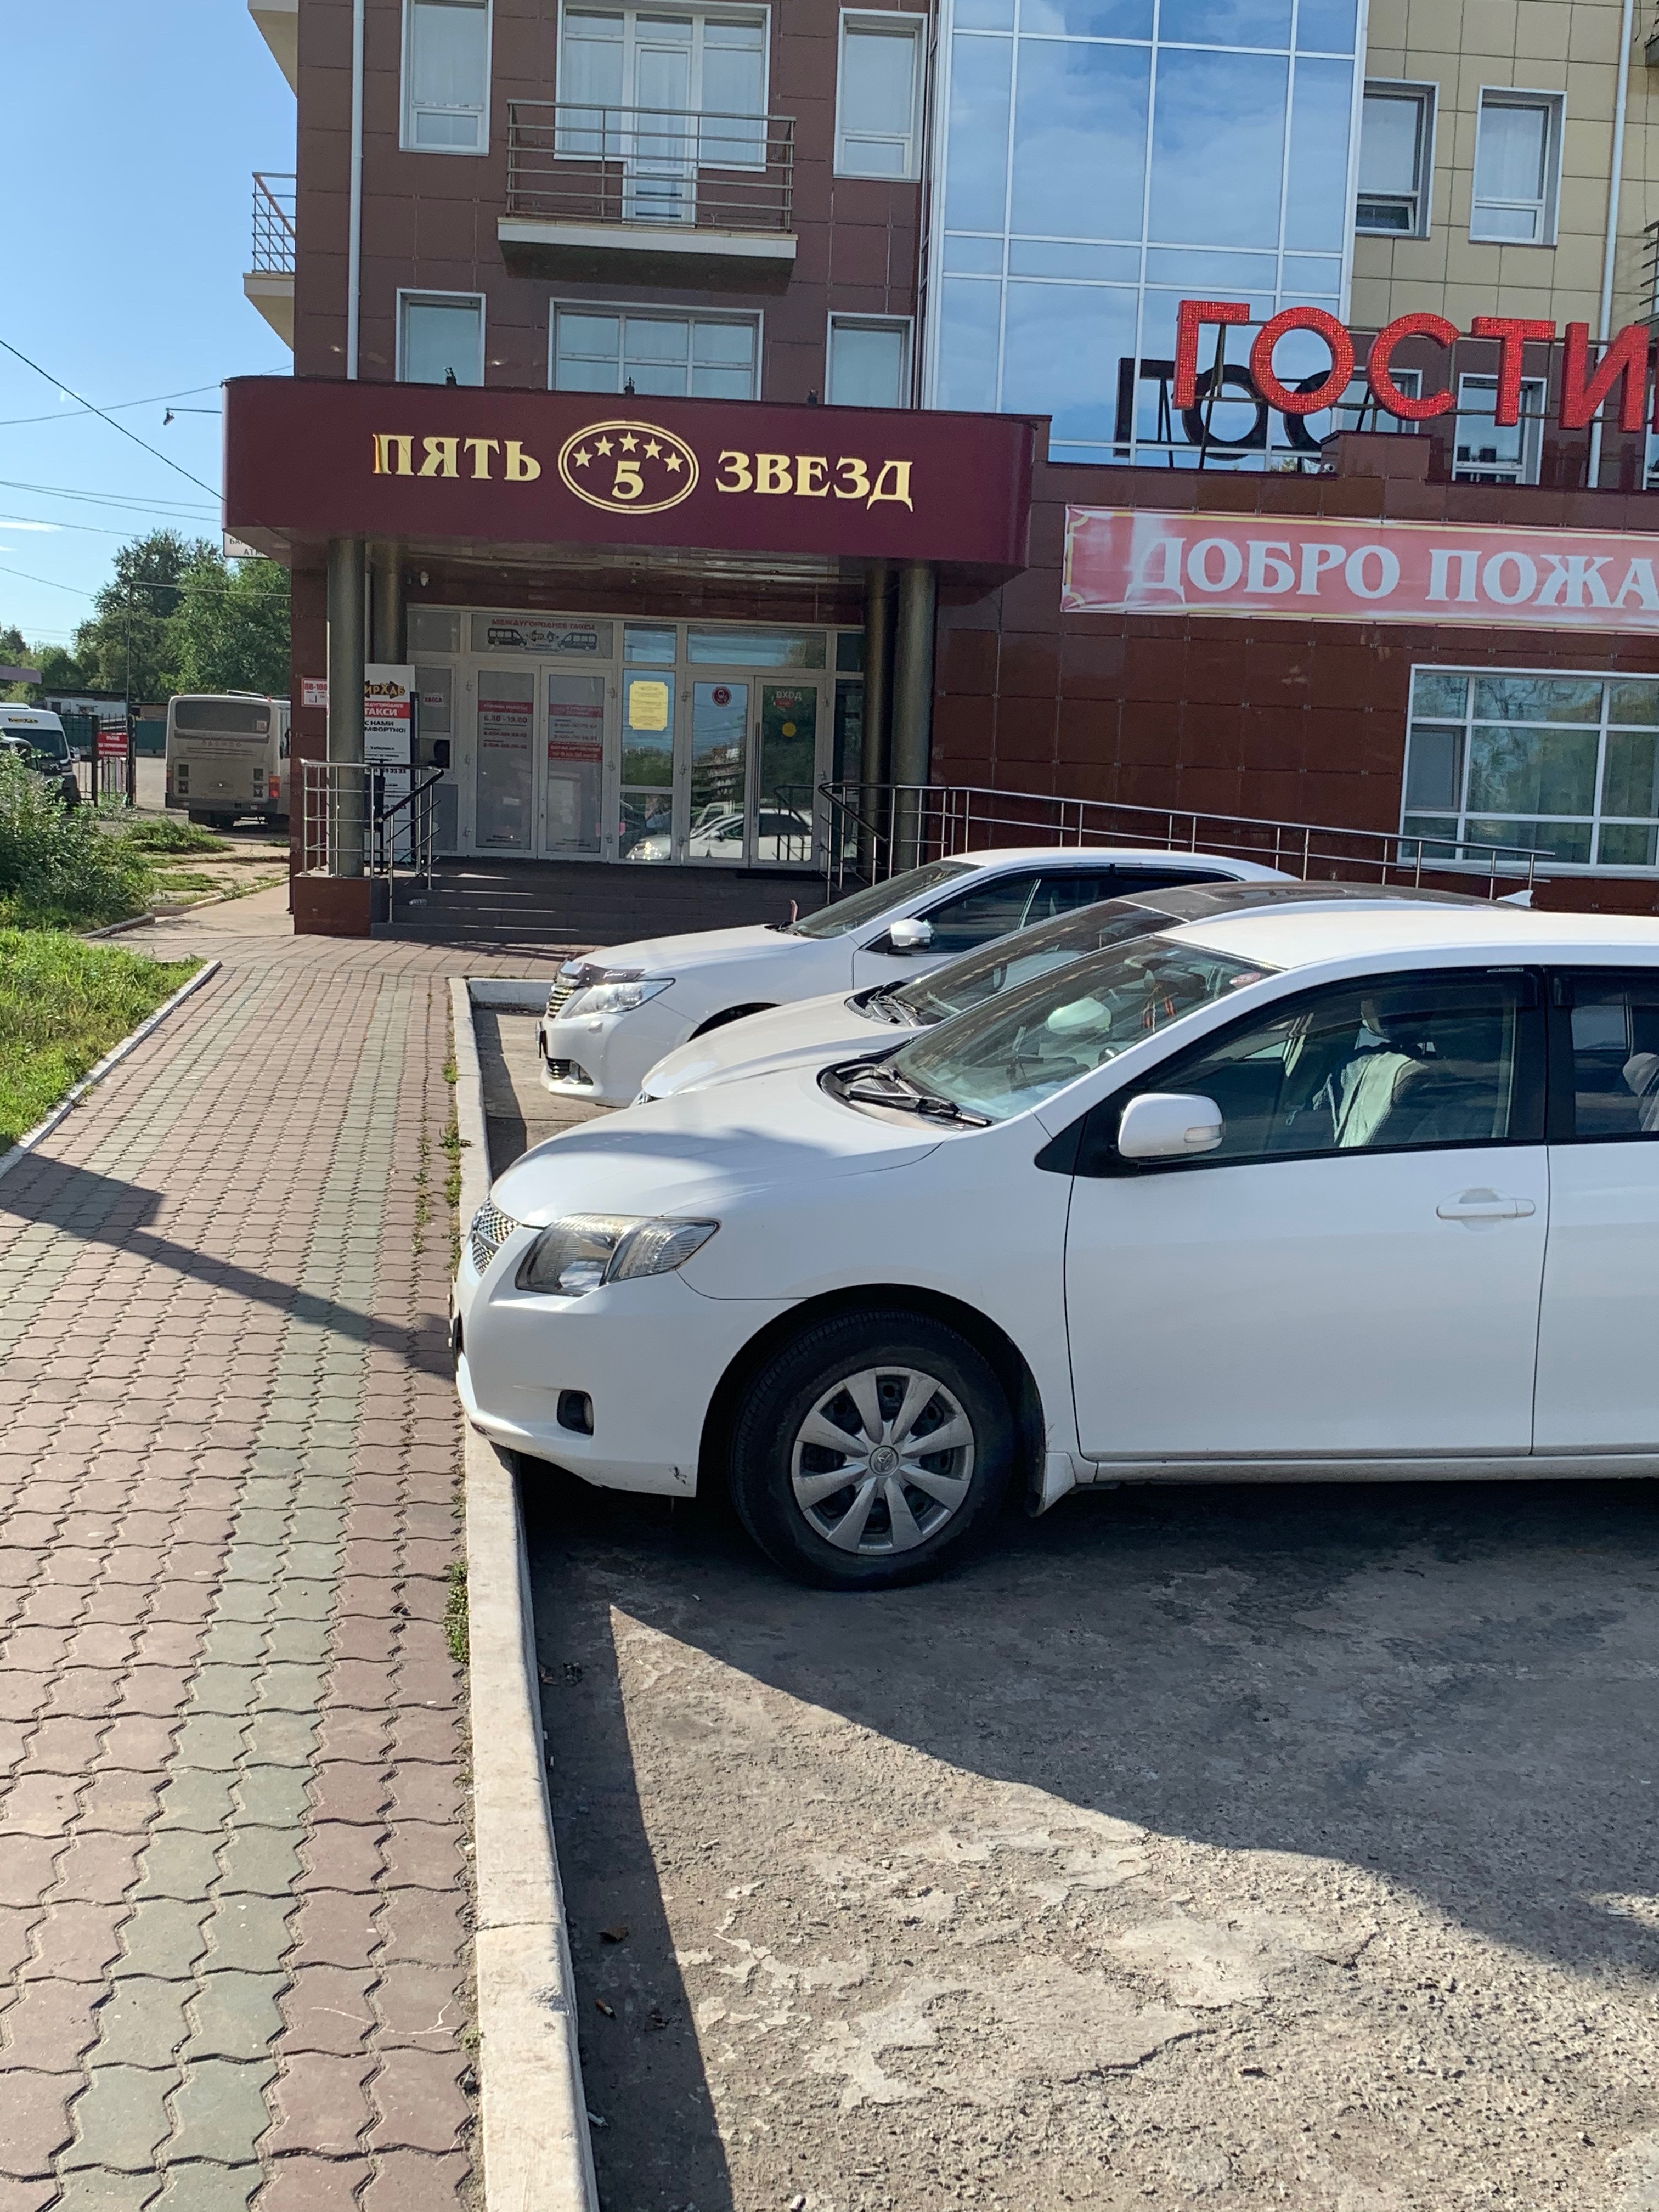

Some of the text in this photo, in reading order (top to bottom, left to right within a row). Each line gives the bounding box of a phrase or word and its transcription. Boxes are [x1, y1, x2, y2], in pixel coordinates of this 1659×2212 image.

[1172, 300, 1659, 433] ГОСТИ
[372, 433, 914, 512] ПЯТЬ ЗВЕЗД
[612, 460, 646, 500] 5
[1125, 537, 1659, 610] ДОБРО ПОЖА
[364, 683, 405, 696] ИРХАБ
[776, 691, 802, 701] ВХОД
